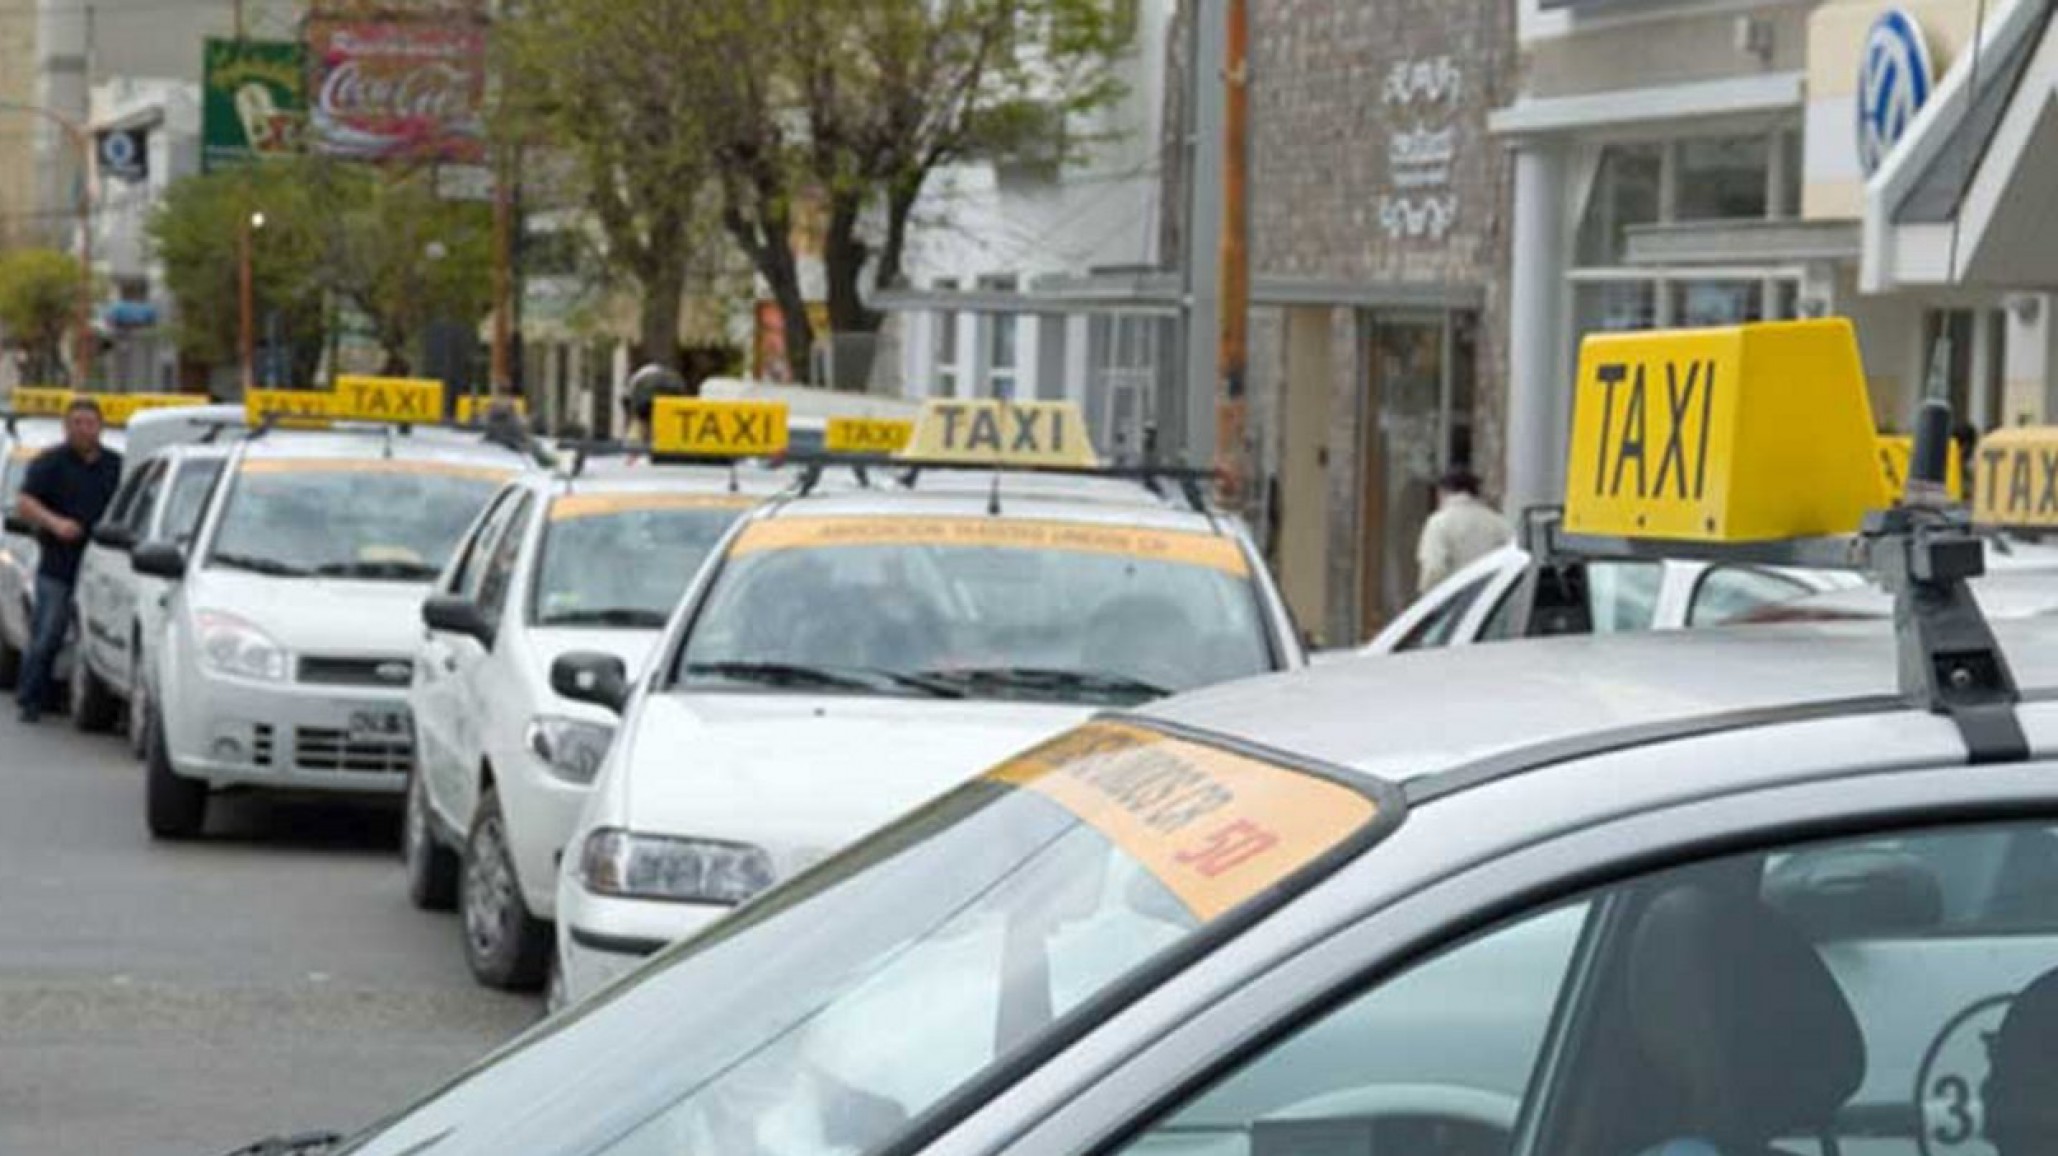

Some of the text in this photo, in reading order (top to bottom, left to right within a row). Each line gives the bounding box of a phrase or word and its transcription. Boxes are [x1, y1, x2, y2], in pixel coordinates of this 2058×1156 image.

[348, 382, 430, 415] TAXI
[673, 409, 774, 446] TAXI
[841, 420, 905, 444] TAXI
[934, 404, 1063, 449] TAXI
[1595, 359, 1716, 500] TAXI
[1174, 817, 1280, 876] 50
